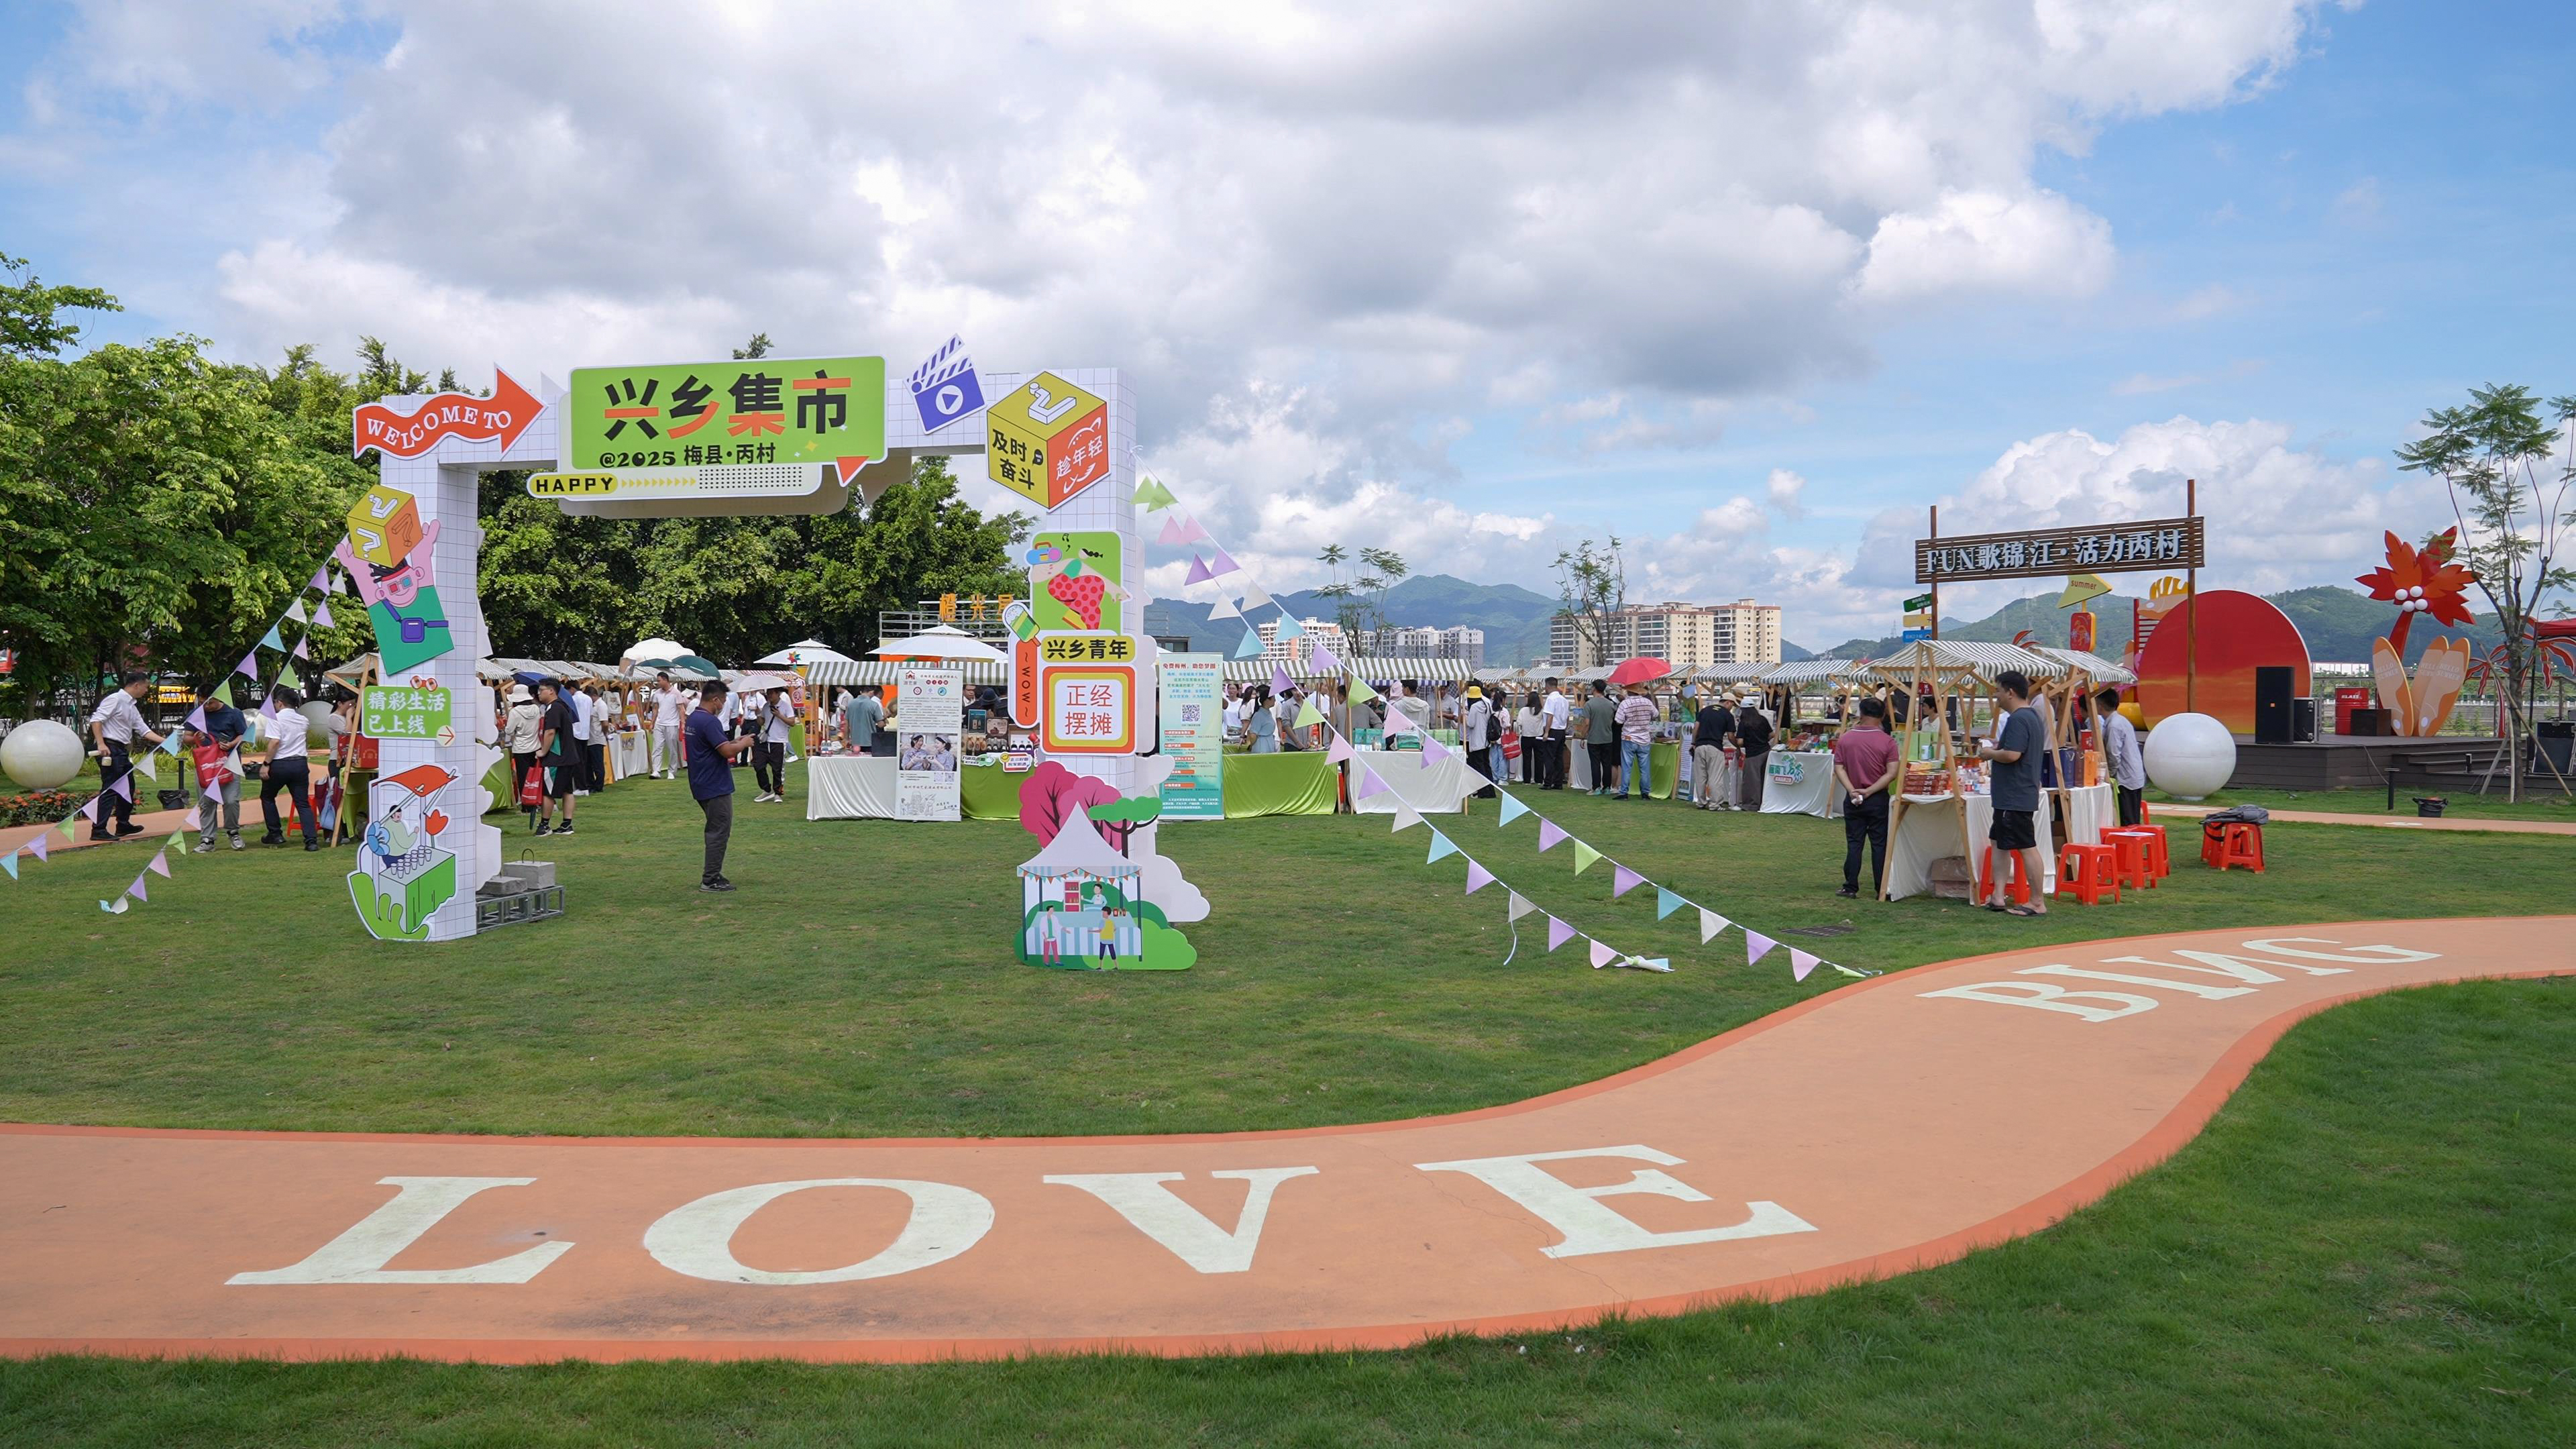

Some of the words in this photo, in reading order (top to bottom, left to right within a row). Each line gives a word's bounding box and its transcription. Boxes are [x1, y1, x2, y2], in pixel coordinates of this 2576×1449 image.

[603, 368, 851, 440] 兴乡集市
[366, 405, 478, 449] WELCOME
[483, 410, 512, 429] TO
[599, 450, 676, 468] @2025
[684, 442, 776, 466] 梅县·丙村
[992, 428, 1027, 462] 及时
[1056, 435, 1104, 481] 趁年轻
[536, 476, 614, 494] HAPPY
[999, 457, 1035, 490] 奋斗
[2071, 580, 2097, 590] summer
[1046, 639, 1128, 659] 兴乡青年
[368, 691, 446, 712] 精彩生活
[1066, 684, 1113, 707] 正经
[368, 714, 426, 735] 已上线
[1065, 711, 1113, 736] 摆摊
[1916, 936, 2444, 1022] BING
[224, 1144, 1819, 1287] LOVE
